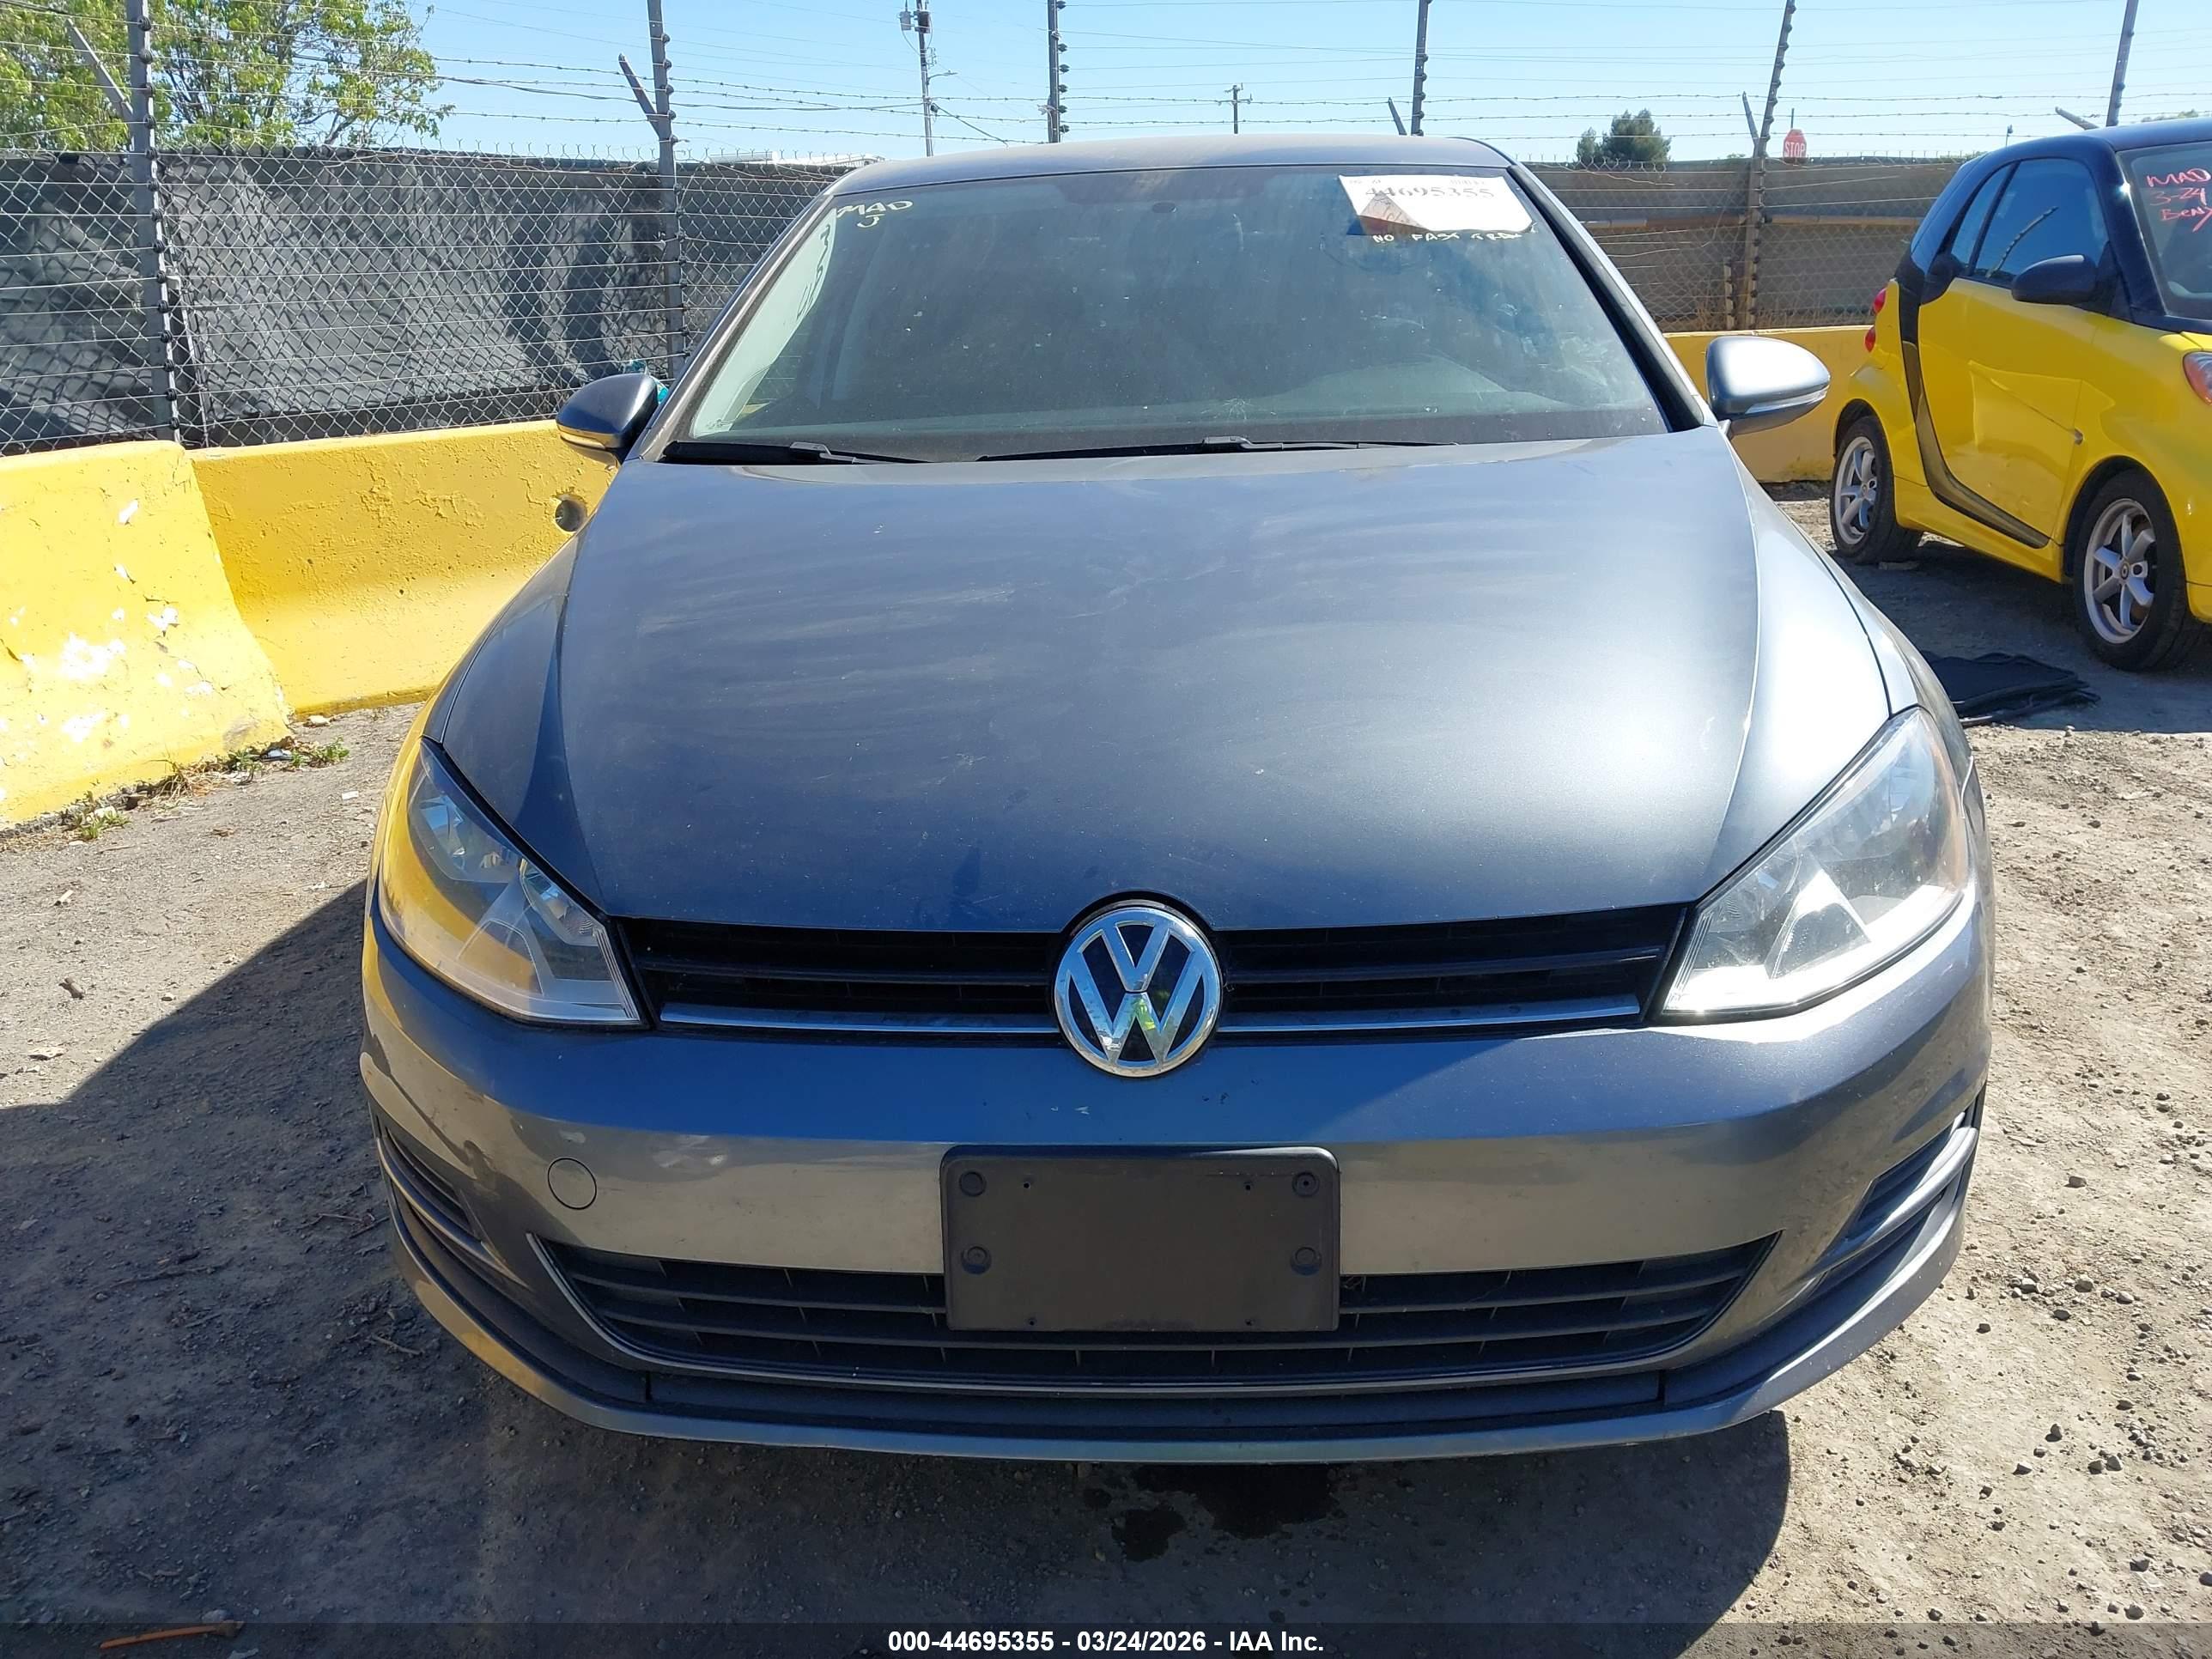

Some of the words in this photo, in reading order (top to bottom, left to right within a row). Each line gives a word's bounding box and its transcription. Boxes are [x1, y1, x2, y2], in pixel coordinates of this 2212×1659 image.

[1784, 141, 1806, 158] STOP
[2147, 167, 2212, 187] MAD
[1365, 186, 1495, 199] 44695355
[836, 200, 914, 218] MAD
[1373, 234, 1395, 244] NO
